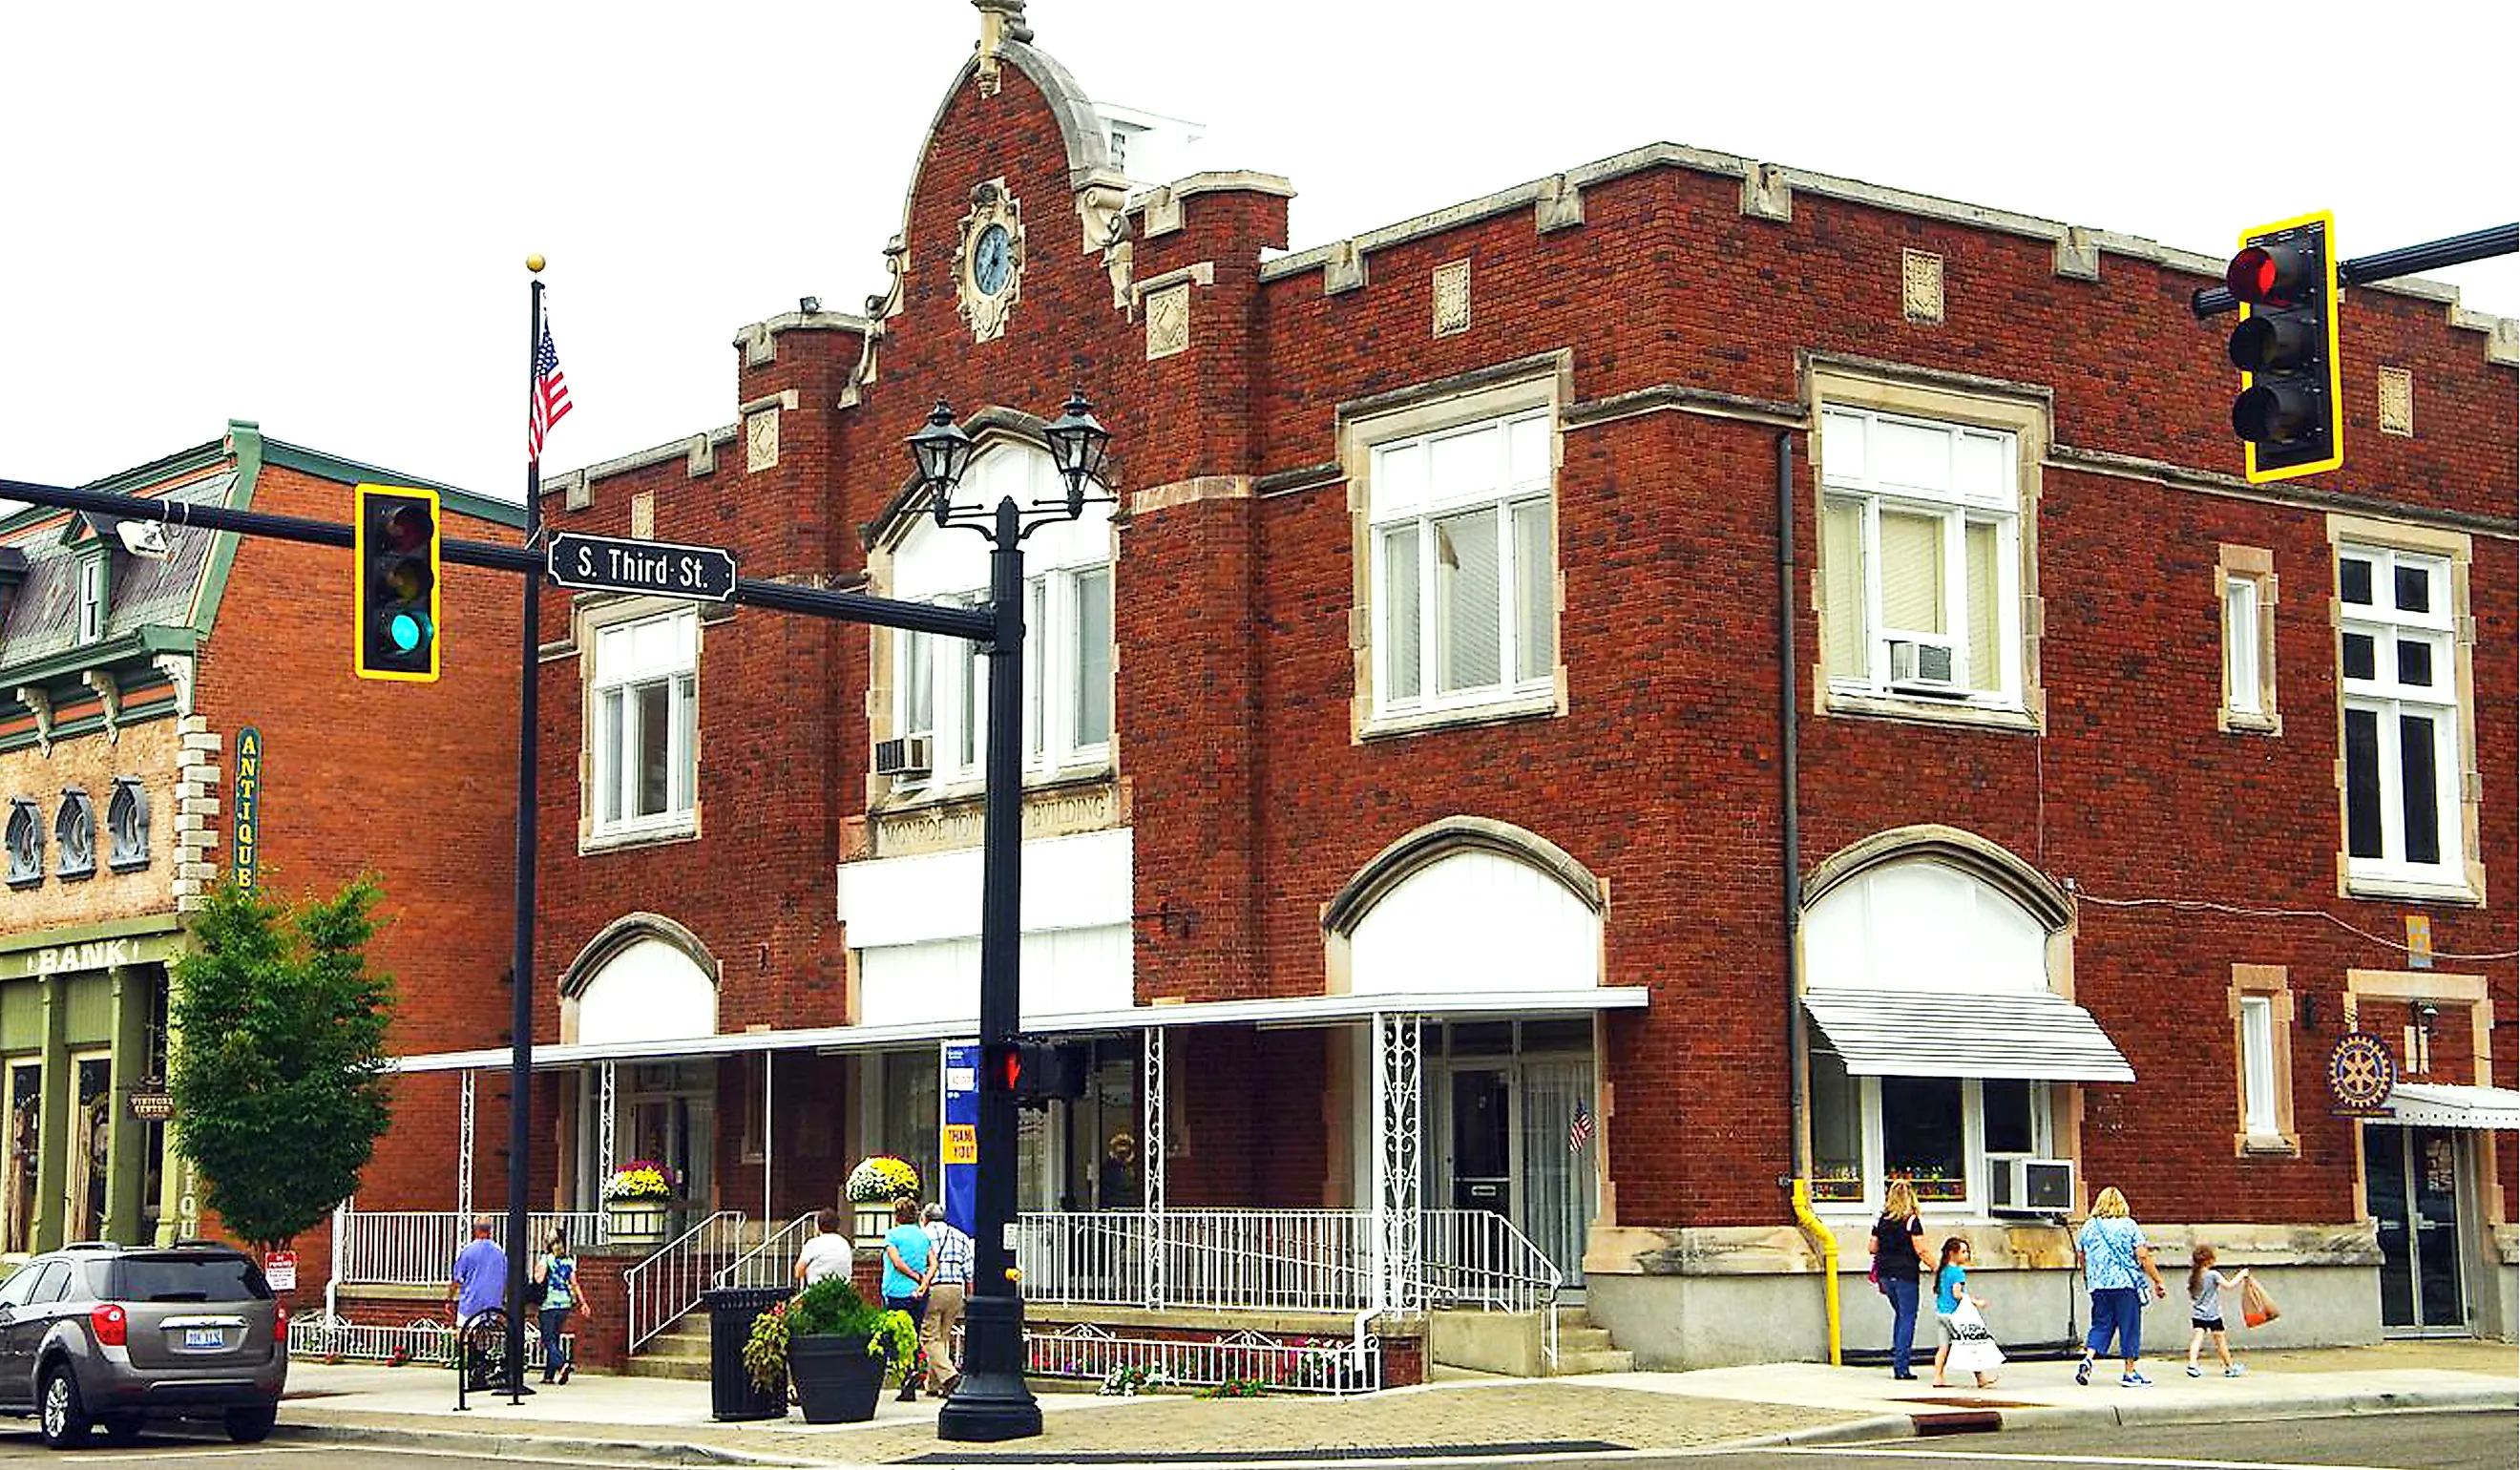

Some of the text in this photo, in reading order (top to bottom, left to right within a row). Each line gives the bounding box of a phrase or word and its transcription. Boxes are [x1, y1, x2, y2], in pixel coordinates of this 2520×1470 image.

[577, 546, 708, 588] S. Third St.
[38, 938, 127, 974] BANK
